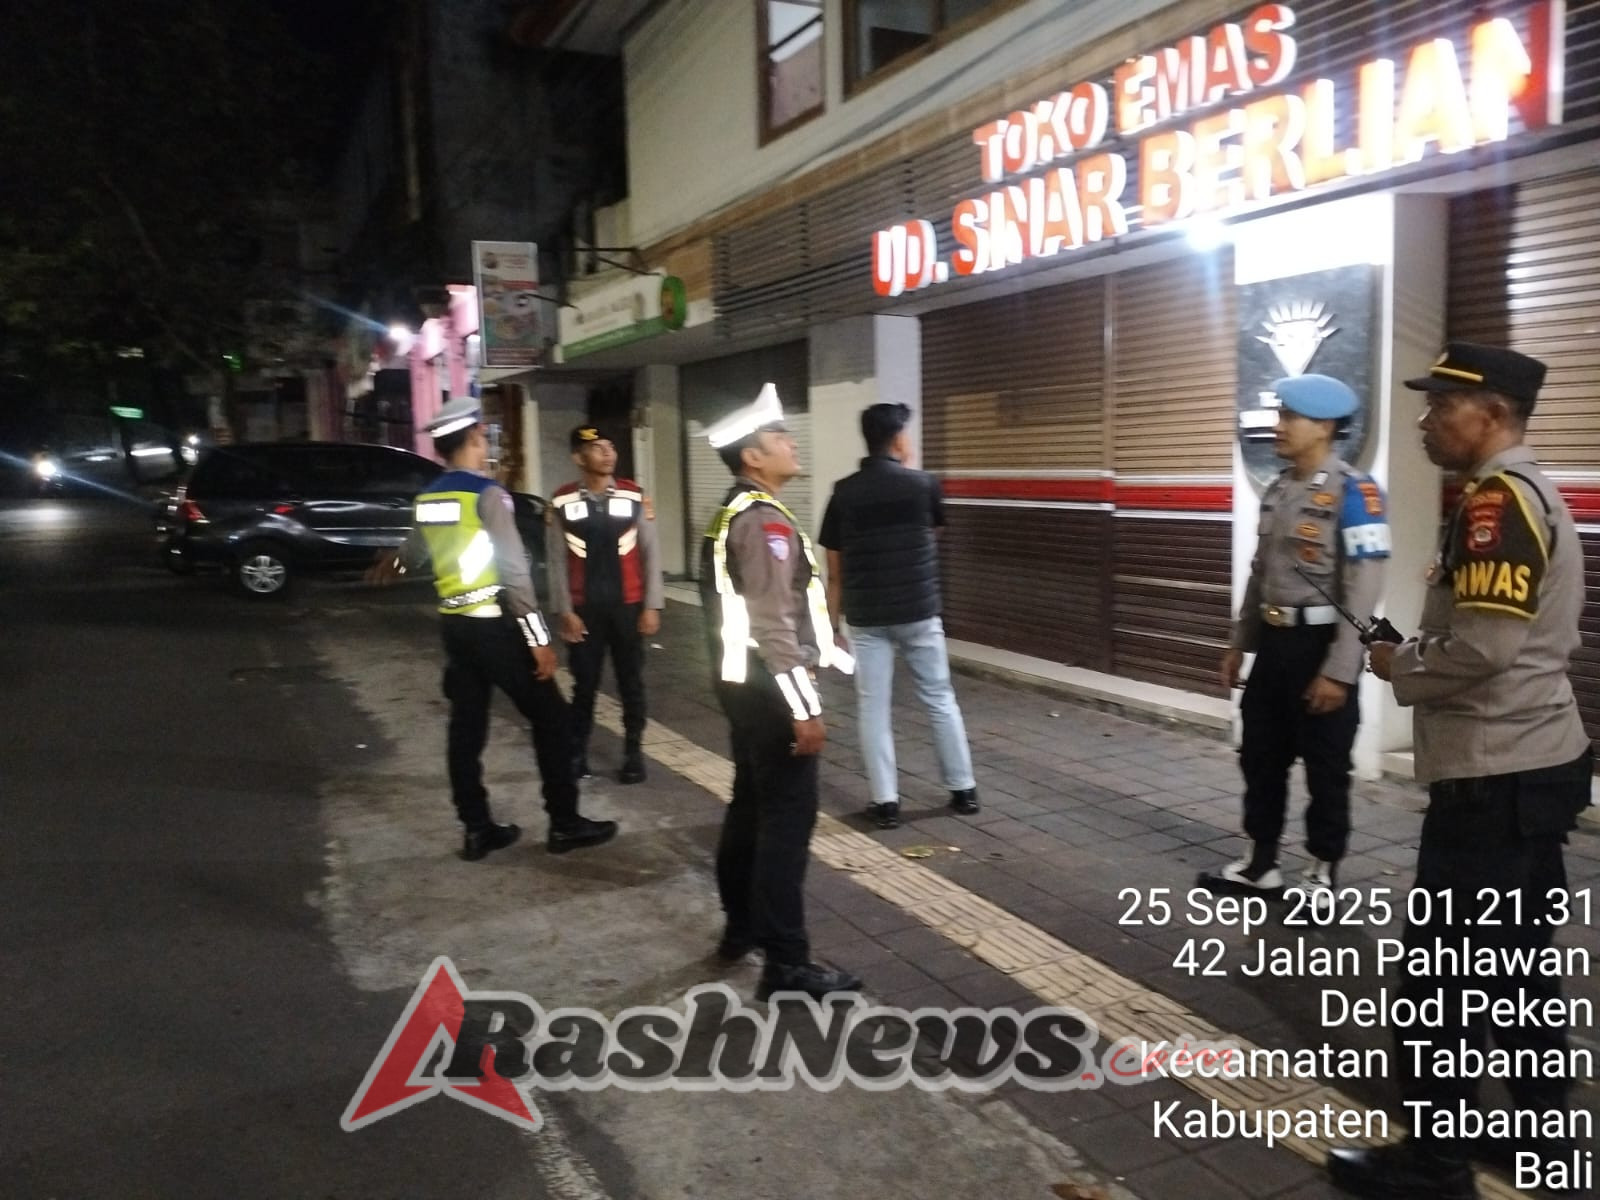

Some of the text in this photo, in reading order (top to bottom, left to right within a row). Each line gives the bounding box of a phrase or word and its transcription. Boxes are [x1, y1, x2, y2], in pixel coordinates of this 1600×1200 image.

[871, 0, 1564, 297] UD. SINAR BERLIAN
[973, 3, 1297, 183] TOKO EMAS
